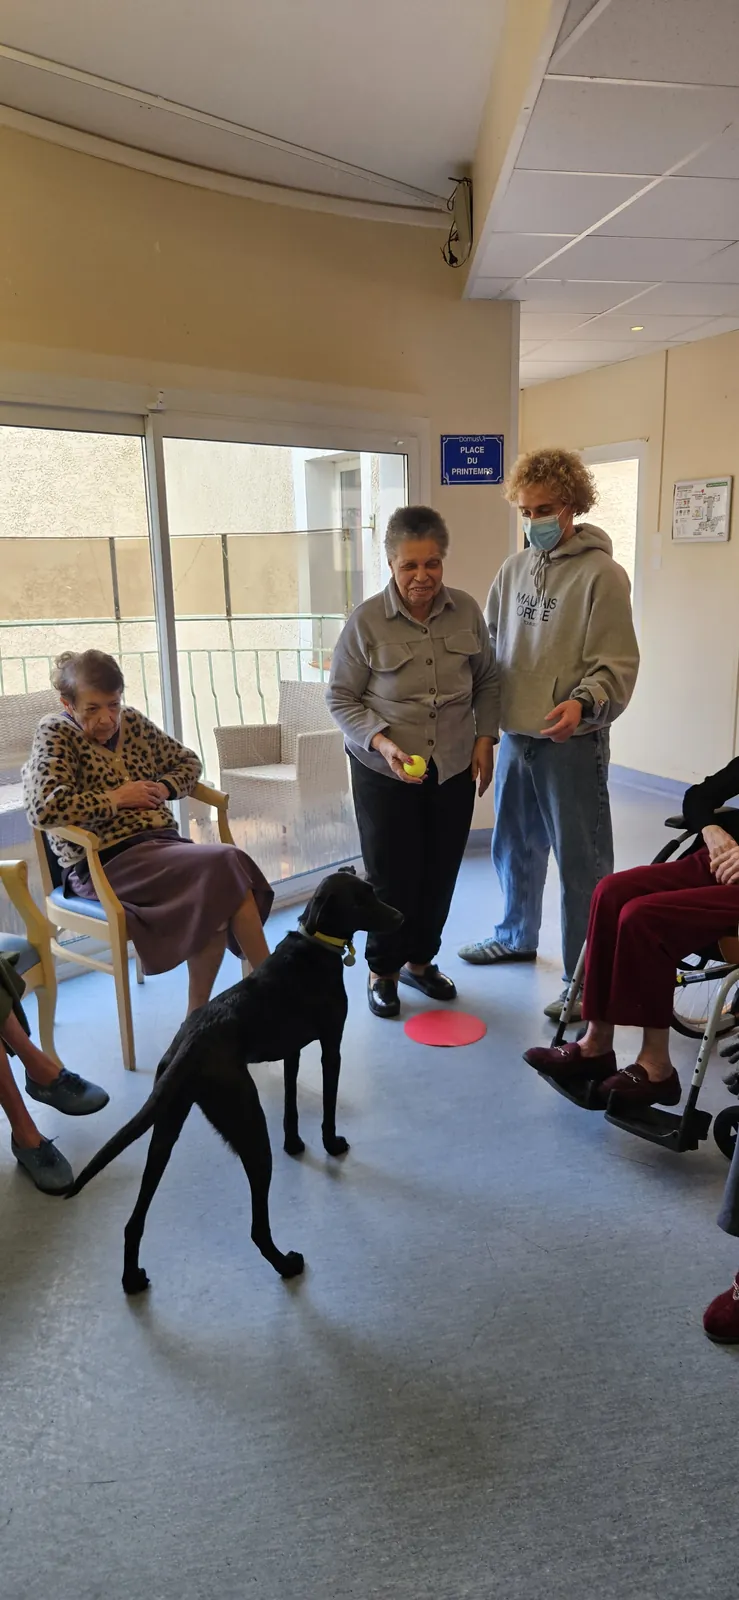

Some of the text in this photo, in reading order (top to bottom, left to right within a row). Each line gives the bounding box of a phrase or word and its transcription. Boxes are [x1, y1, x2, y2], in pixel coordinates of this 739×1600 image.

[460, 446, 485, 454] PLACE
[451, 467, 493, 475] PRINTEMPS
[516, 605, 550, 621] ORDE
